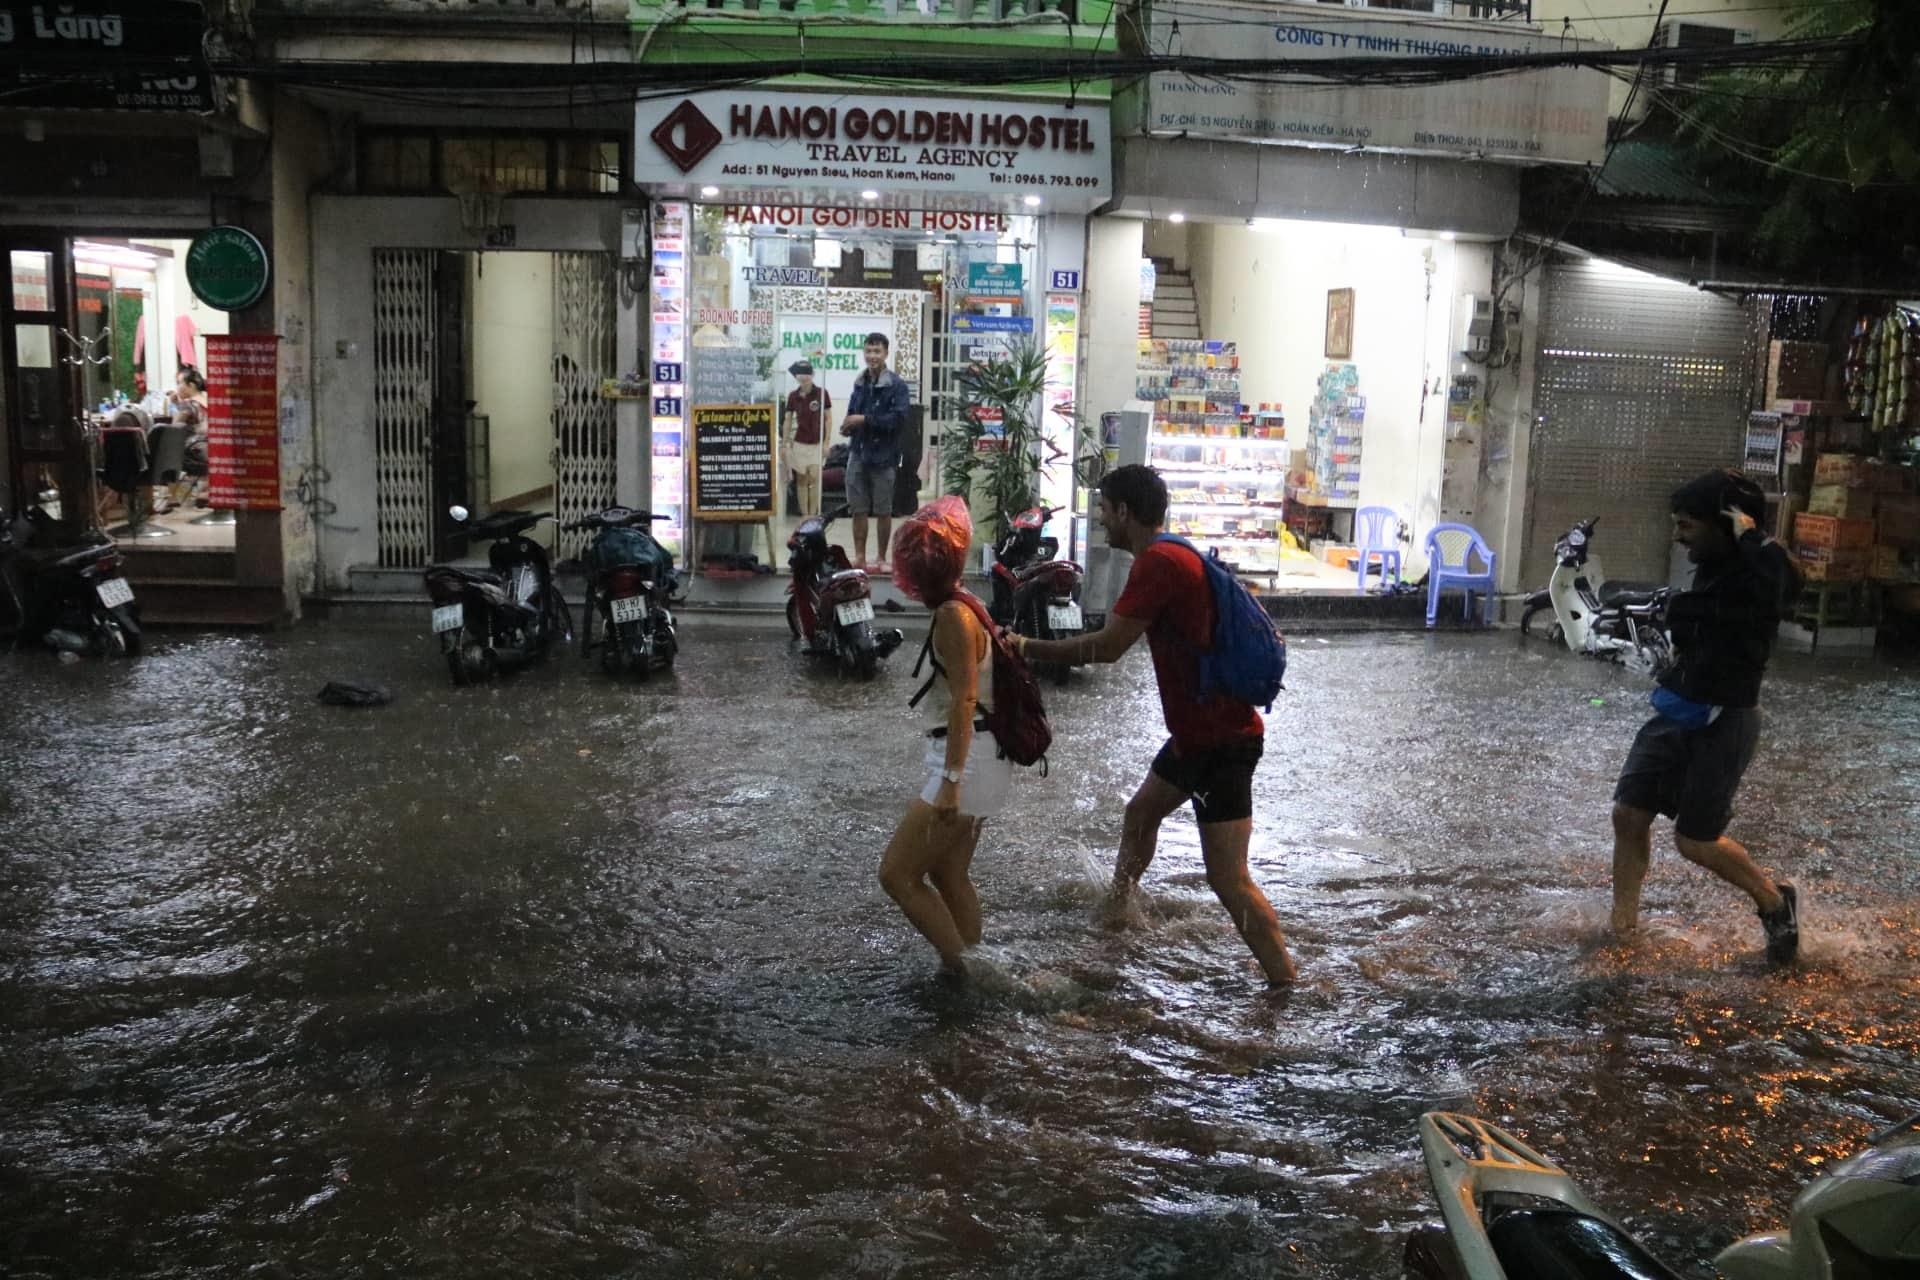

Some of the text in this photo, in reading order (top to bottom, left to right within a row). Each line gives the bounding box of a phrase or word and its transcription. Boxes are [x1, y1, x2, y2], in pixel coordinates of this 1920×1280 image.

[1331, 31, 1350, 48] TY
[1357, 35, 1400, 52] TNHH
[730, 103, 1095, 151] HANOI GOLDEN HOSTEL
[806, 143, 1019, 168] TRAVEL AGENCY
[722, 164, 753, 175] Add:
[757, 165, 769, 175] 51
[772, 165, 818, 178] Nguyen
[852, 167, 884, 179] Hoan
[921, 171, 956, 182] Hanoi
[990, 172, 1012, 184] Tel:
[723, 206, 803, 226] HANOI
[922, 210, 1008, 233] HOSTEL
[742, 266, 820, 284] TRAVEL
[1056, 272, 1074, 288] 51
[699, 309, 739, 325] BOOKING
[742, 310, 773, 325] OFFICE
[971, 348, 1000, 359] Jetstar
[658, 366, 677, 381] 51
[658, 399, 677, 415] 51
[695, 410, 733, 425] Customer
[742, 410, 760, 426] God
